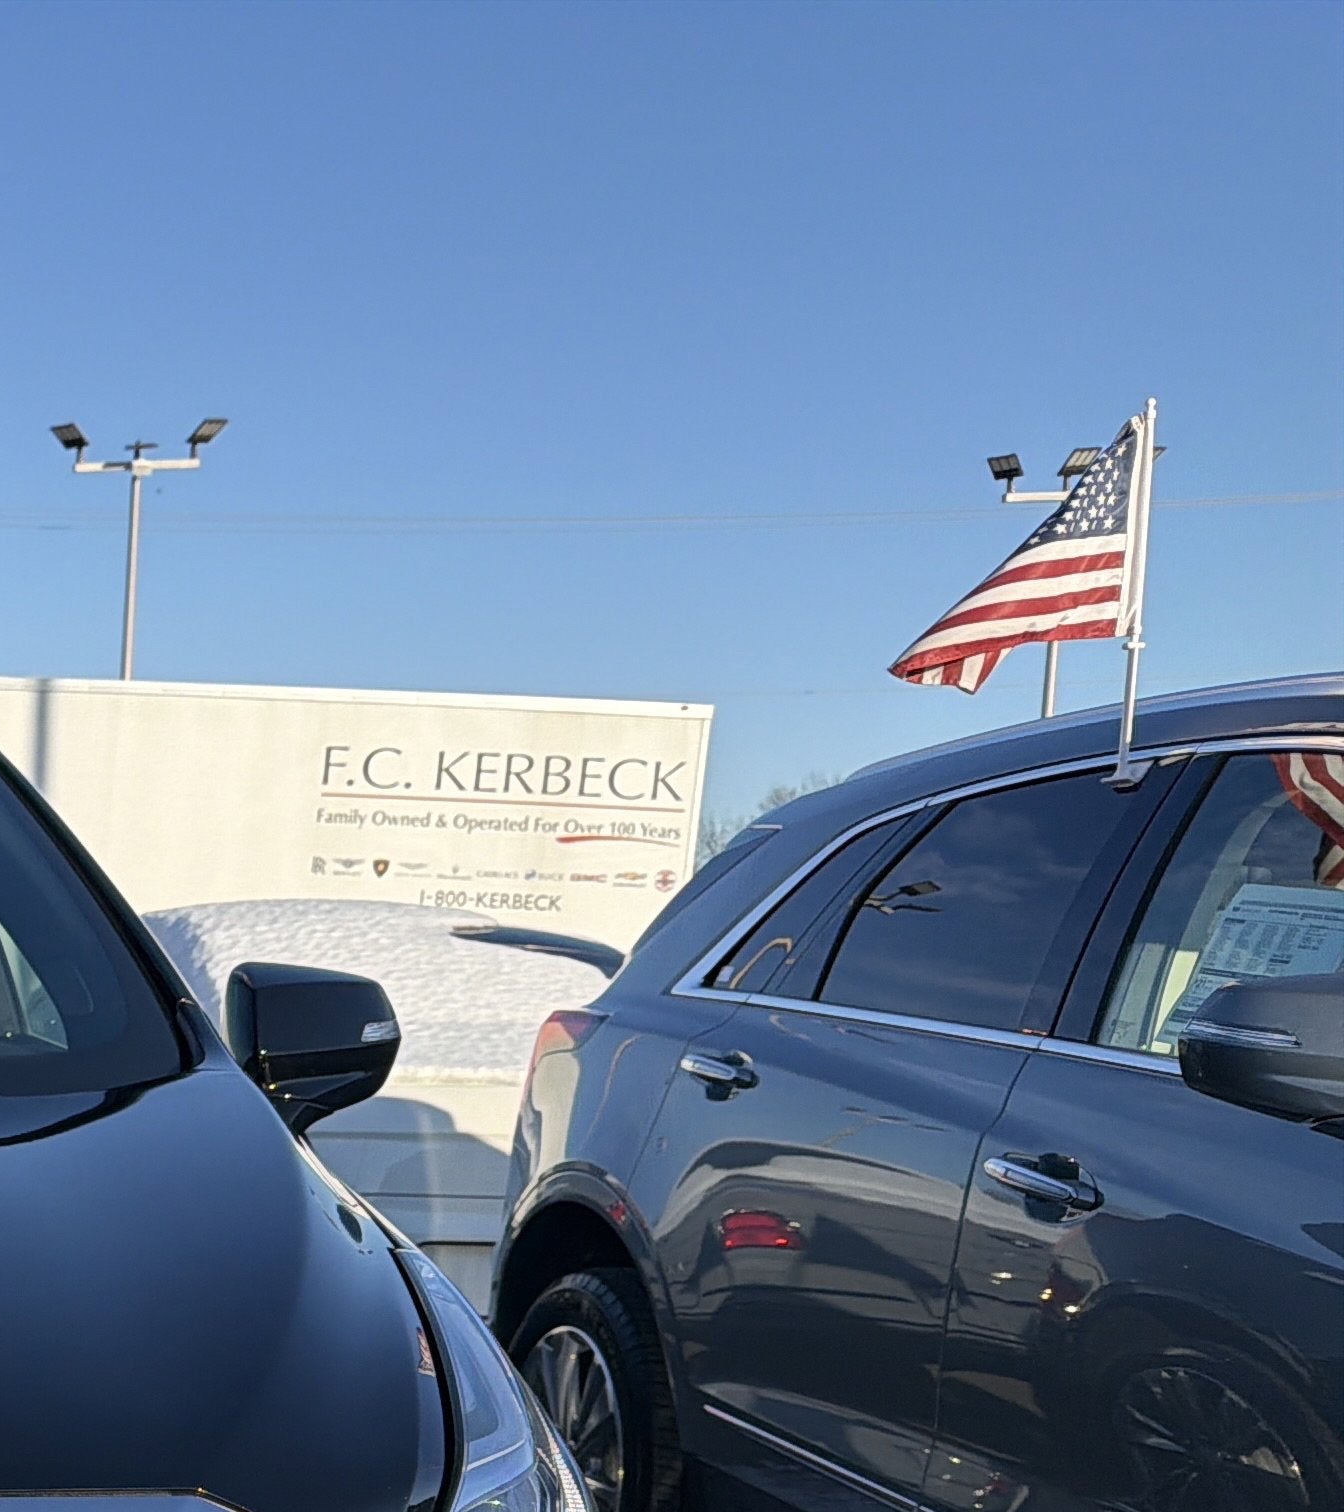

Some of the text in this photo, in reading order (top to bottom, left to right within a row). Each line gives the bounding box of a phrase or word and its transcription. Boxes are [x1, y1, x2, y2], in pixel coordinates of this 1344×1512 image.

[320, 745, 688, 802] F.C. KERBECK
[316, 808, 681, 840] Family Owned & Operated For Over 100 Years
[419, 889, 562, 913] 1-800-KERBECK
